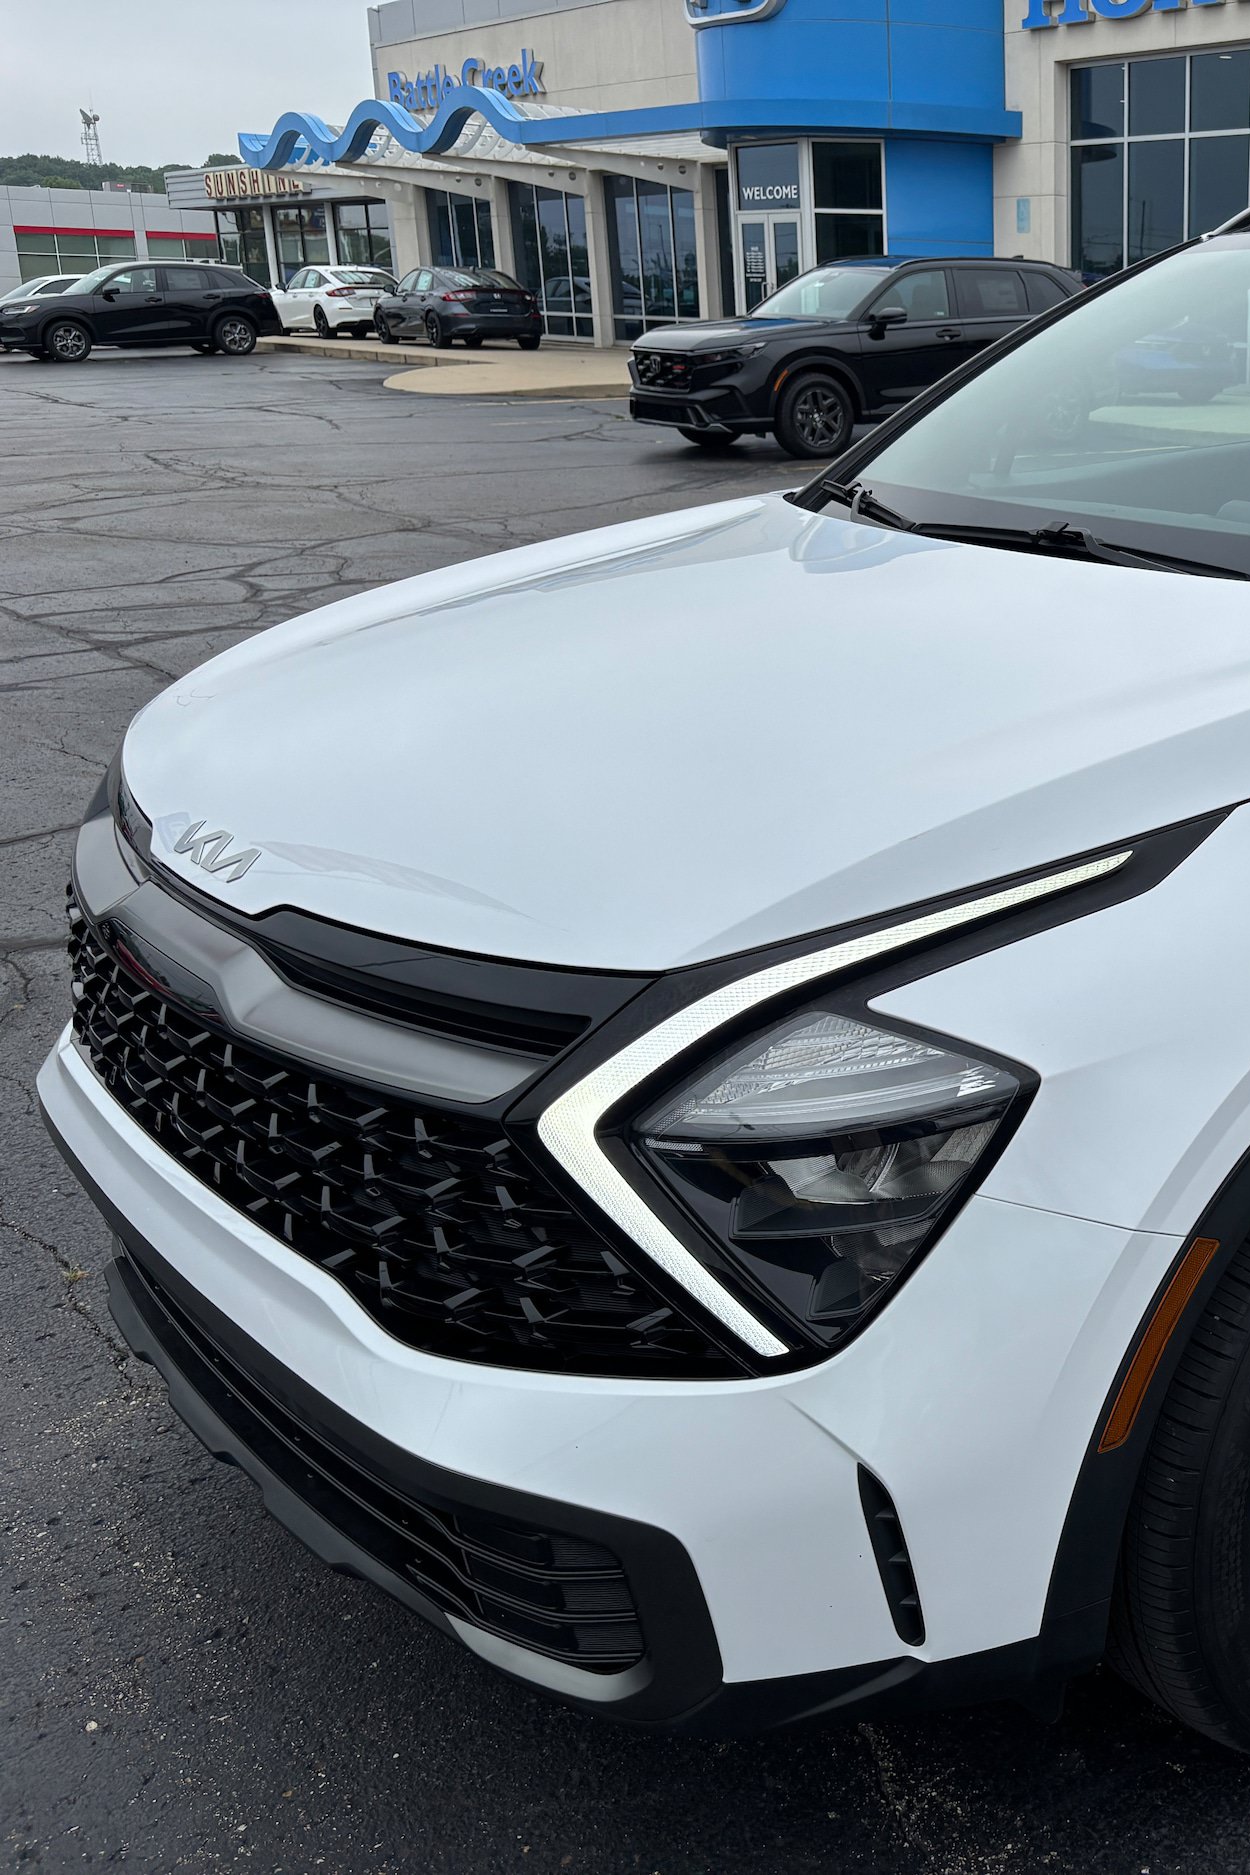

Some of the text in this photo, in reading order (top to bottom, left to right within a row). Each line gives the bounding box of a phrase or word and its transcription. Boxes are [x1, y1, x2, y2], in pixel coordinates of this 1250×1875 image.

[387, 48, 541, 110] Battle Creek
[742, 185, 798, 200] WELCOME
[173, 819, 262, 884] KIA
